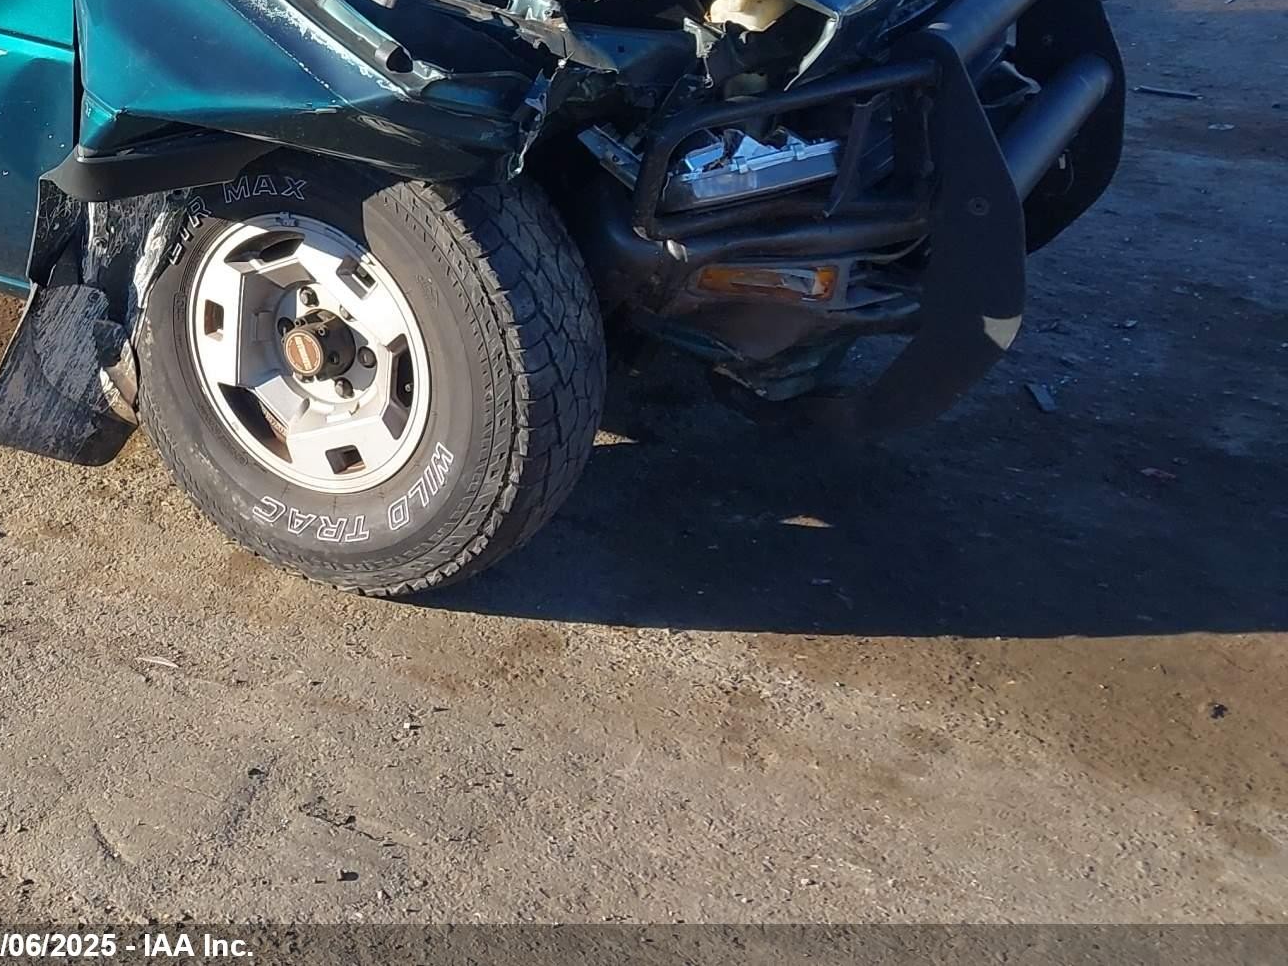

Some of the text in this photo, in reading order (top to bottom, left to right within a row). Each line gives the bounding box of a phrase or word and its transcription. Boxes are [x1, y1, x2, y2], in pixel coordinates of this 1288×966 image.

[222, 174, 307, 204] MAX
[252, 441, 455, 543] WILD TRAC
